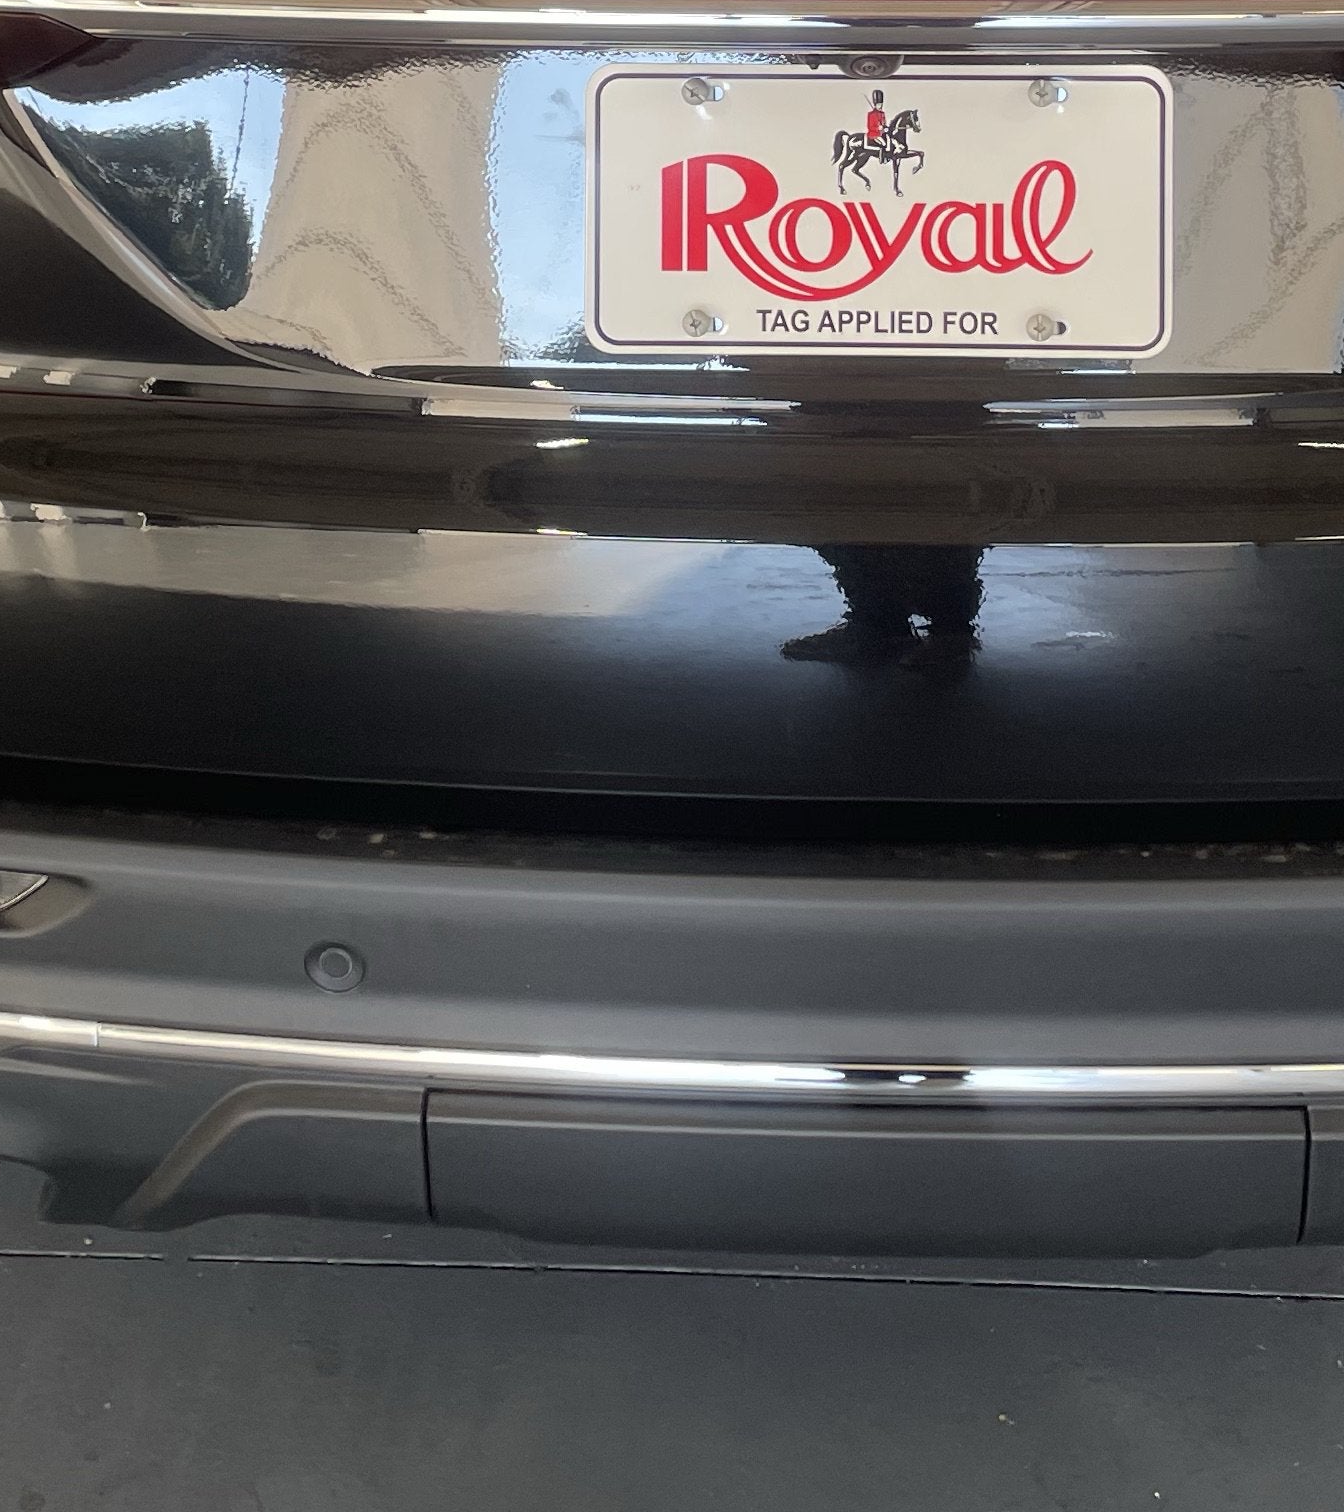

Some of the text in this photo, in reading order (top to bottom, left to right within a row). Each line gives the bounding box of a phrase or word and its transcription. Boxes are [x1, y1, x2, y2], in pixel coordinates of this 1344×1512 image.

[661, 154, 1093, 302] Royal
[756, 309, 998, 336] TAG APPLIED FOR
